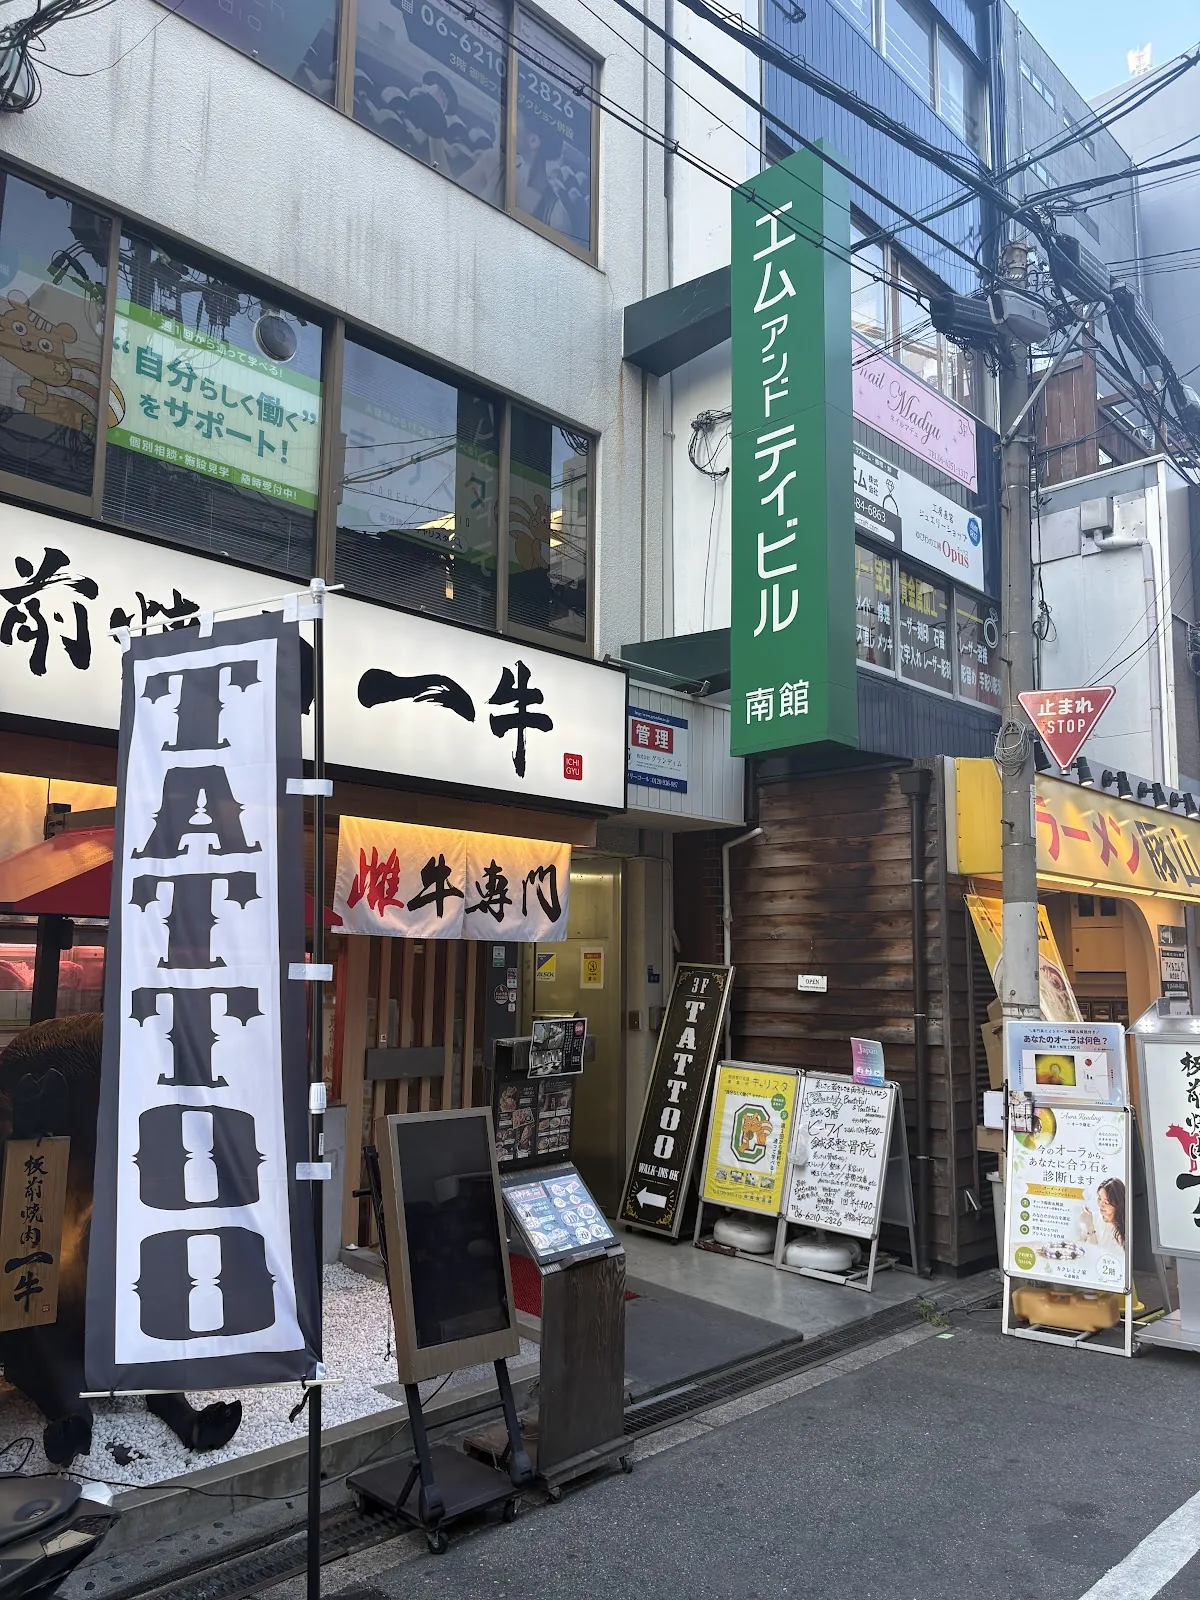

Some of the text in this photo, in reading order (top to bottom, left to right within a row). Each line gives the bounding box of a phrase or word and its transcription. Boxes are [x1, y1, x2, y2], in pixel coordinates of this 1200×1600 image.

[139, 393, 289, 464] をサポート!
[753, 200, 799, 638] エムアンドティビル
[942, 540, 970, 569] Opus
[745, 678, 810, 725] 南館
[1037, 695, 1095, 717] 止まれ
[1046, 718, 1087, 735] STOP
[635, 723, 670, 750] 管理
[565, 757, 581, 767] ICHI
[565, 766, 581, 777] GYU
[691, 977, 710, 994] 3F
[129, 659, 284, 1342] TATTOO
[653, 1000, 706, 1160] TATTOO
[752, 1077, 788, 1092] キャリスタ
[1028, 1156, 1109, 1173] あなたに合う石を
[1042, 1170, 1095, 1186] 診断します
[1102, 1265, 1116, 1276] 2階
